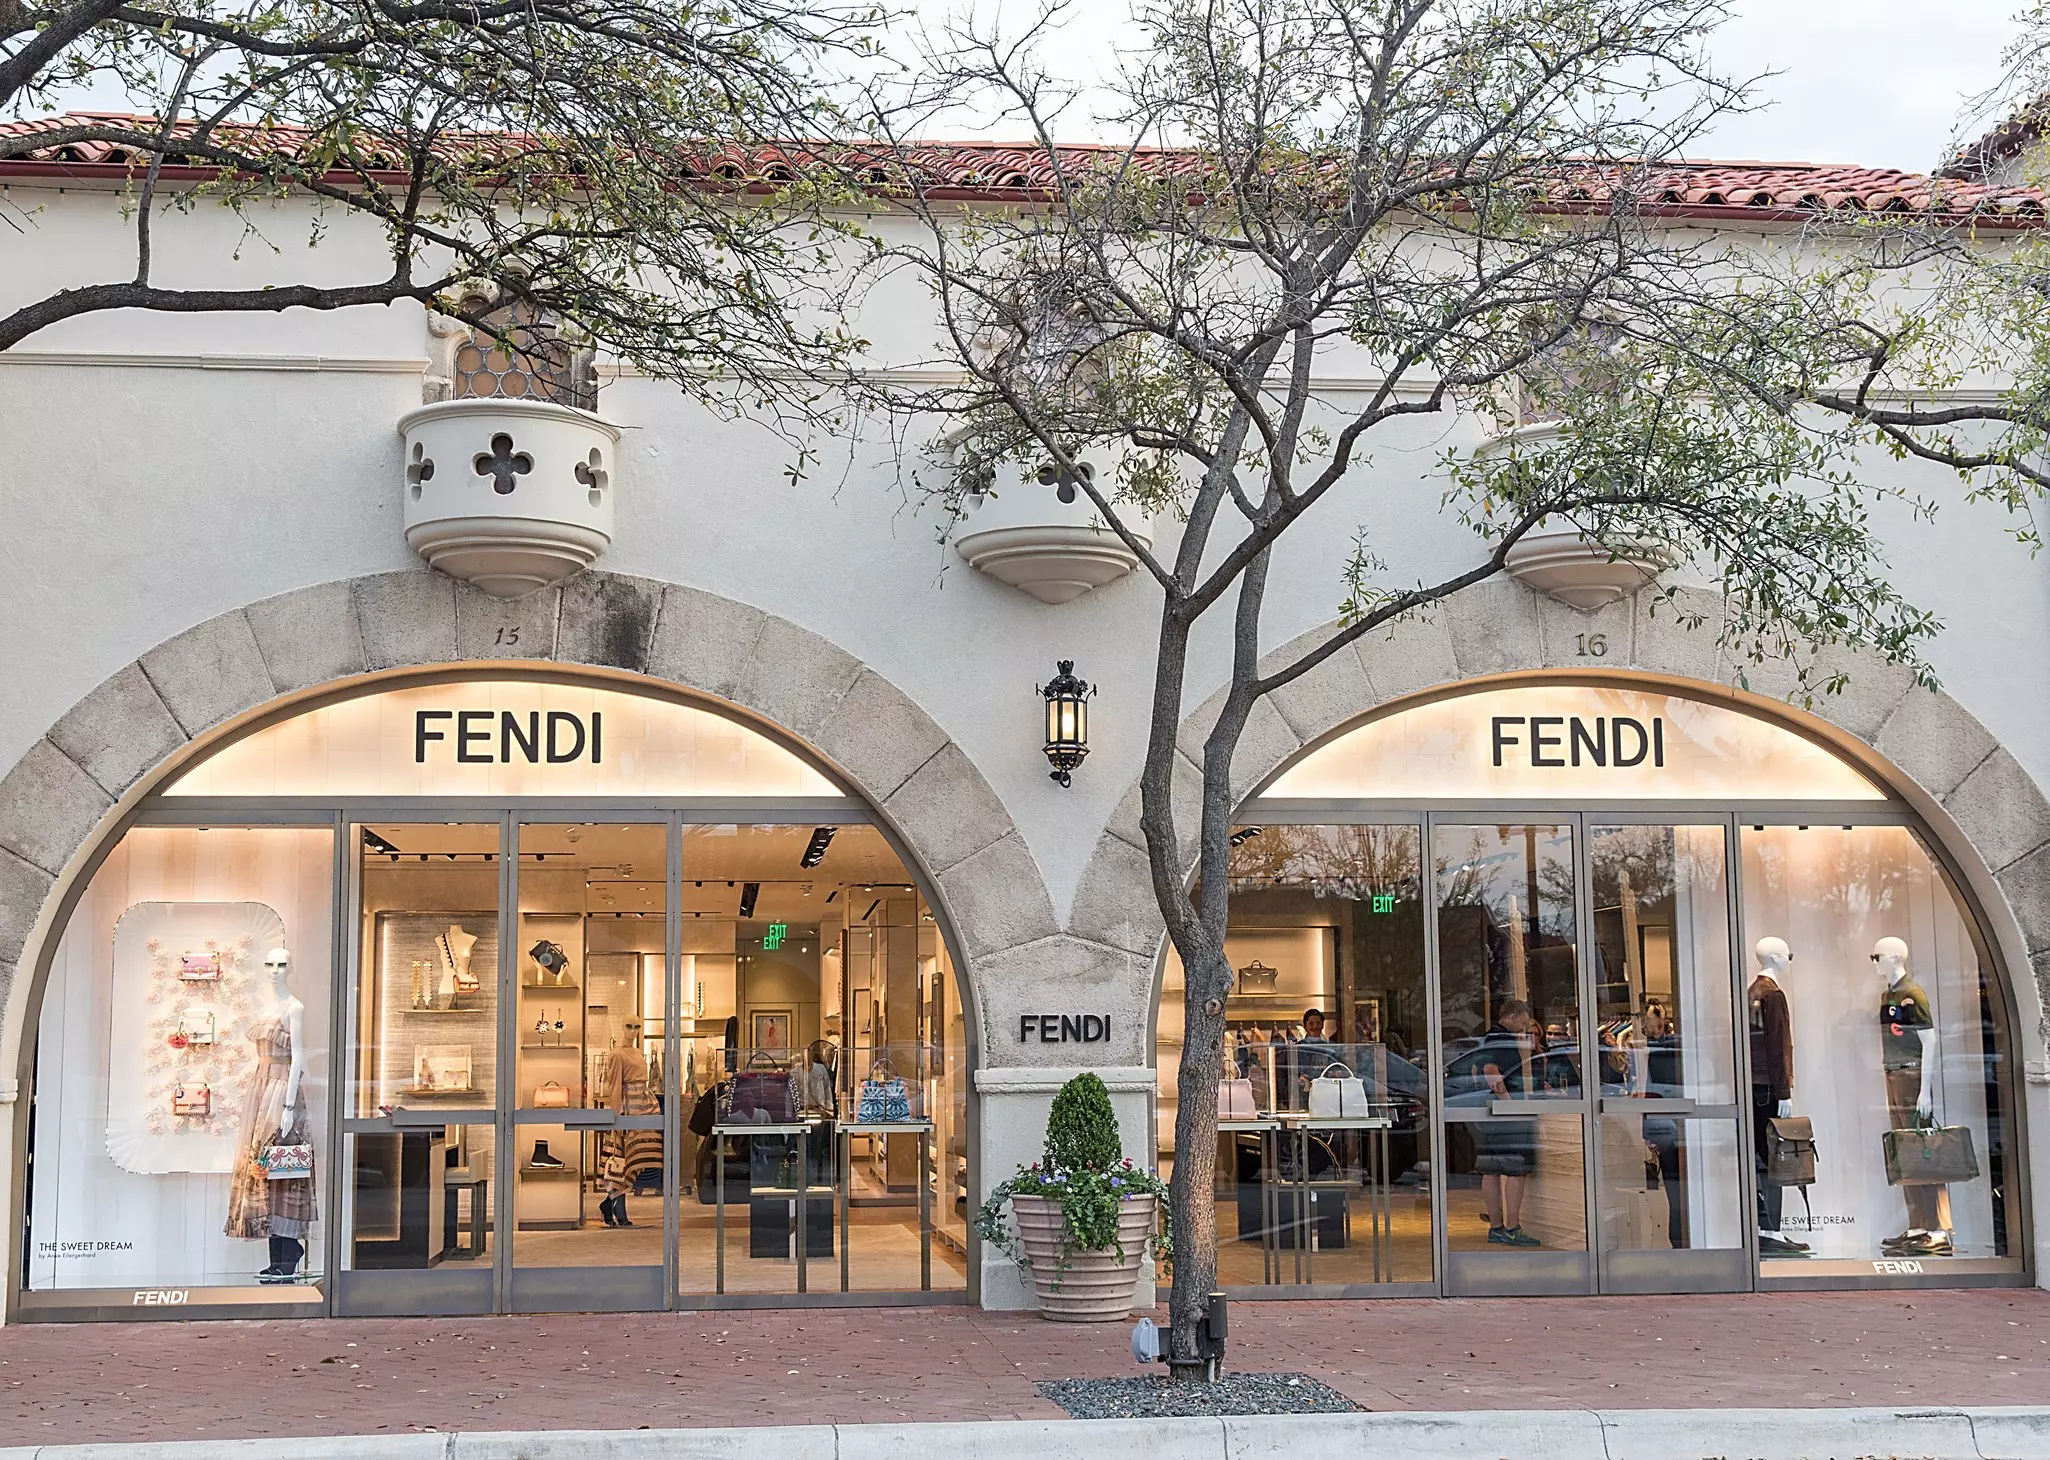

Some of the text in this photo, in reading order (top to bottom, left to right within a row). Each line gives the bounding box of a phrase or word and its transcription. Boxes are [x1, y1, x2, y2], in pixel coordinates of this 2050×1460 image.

[494, 626, 521, 645] 15
[1575, 633, 1608, 657] 16
[415, 711, 601, 764] FENDI
[1492, 716, 1664, 767] FENDI
[1373, 896, 1394, 913] EXIT
[769, 924, 787, 938] EXIT
[763, 936, 780, 950] EXIT
[1020, 1014, 1111, 1043] FENDI
[1823, 1216, 1855, 1225] DREAM
[39, 1241, 133, 1251] THE SWEET DREAM
[1872, 1260, 1924, 1274] FENDI
[133, 1290, 189, 1305] FENDI
